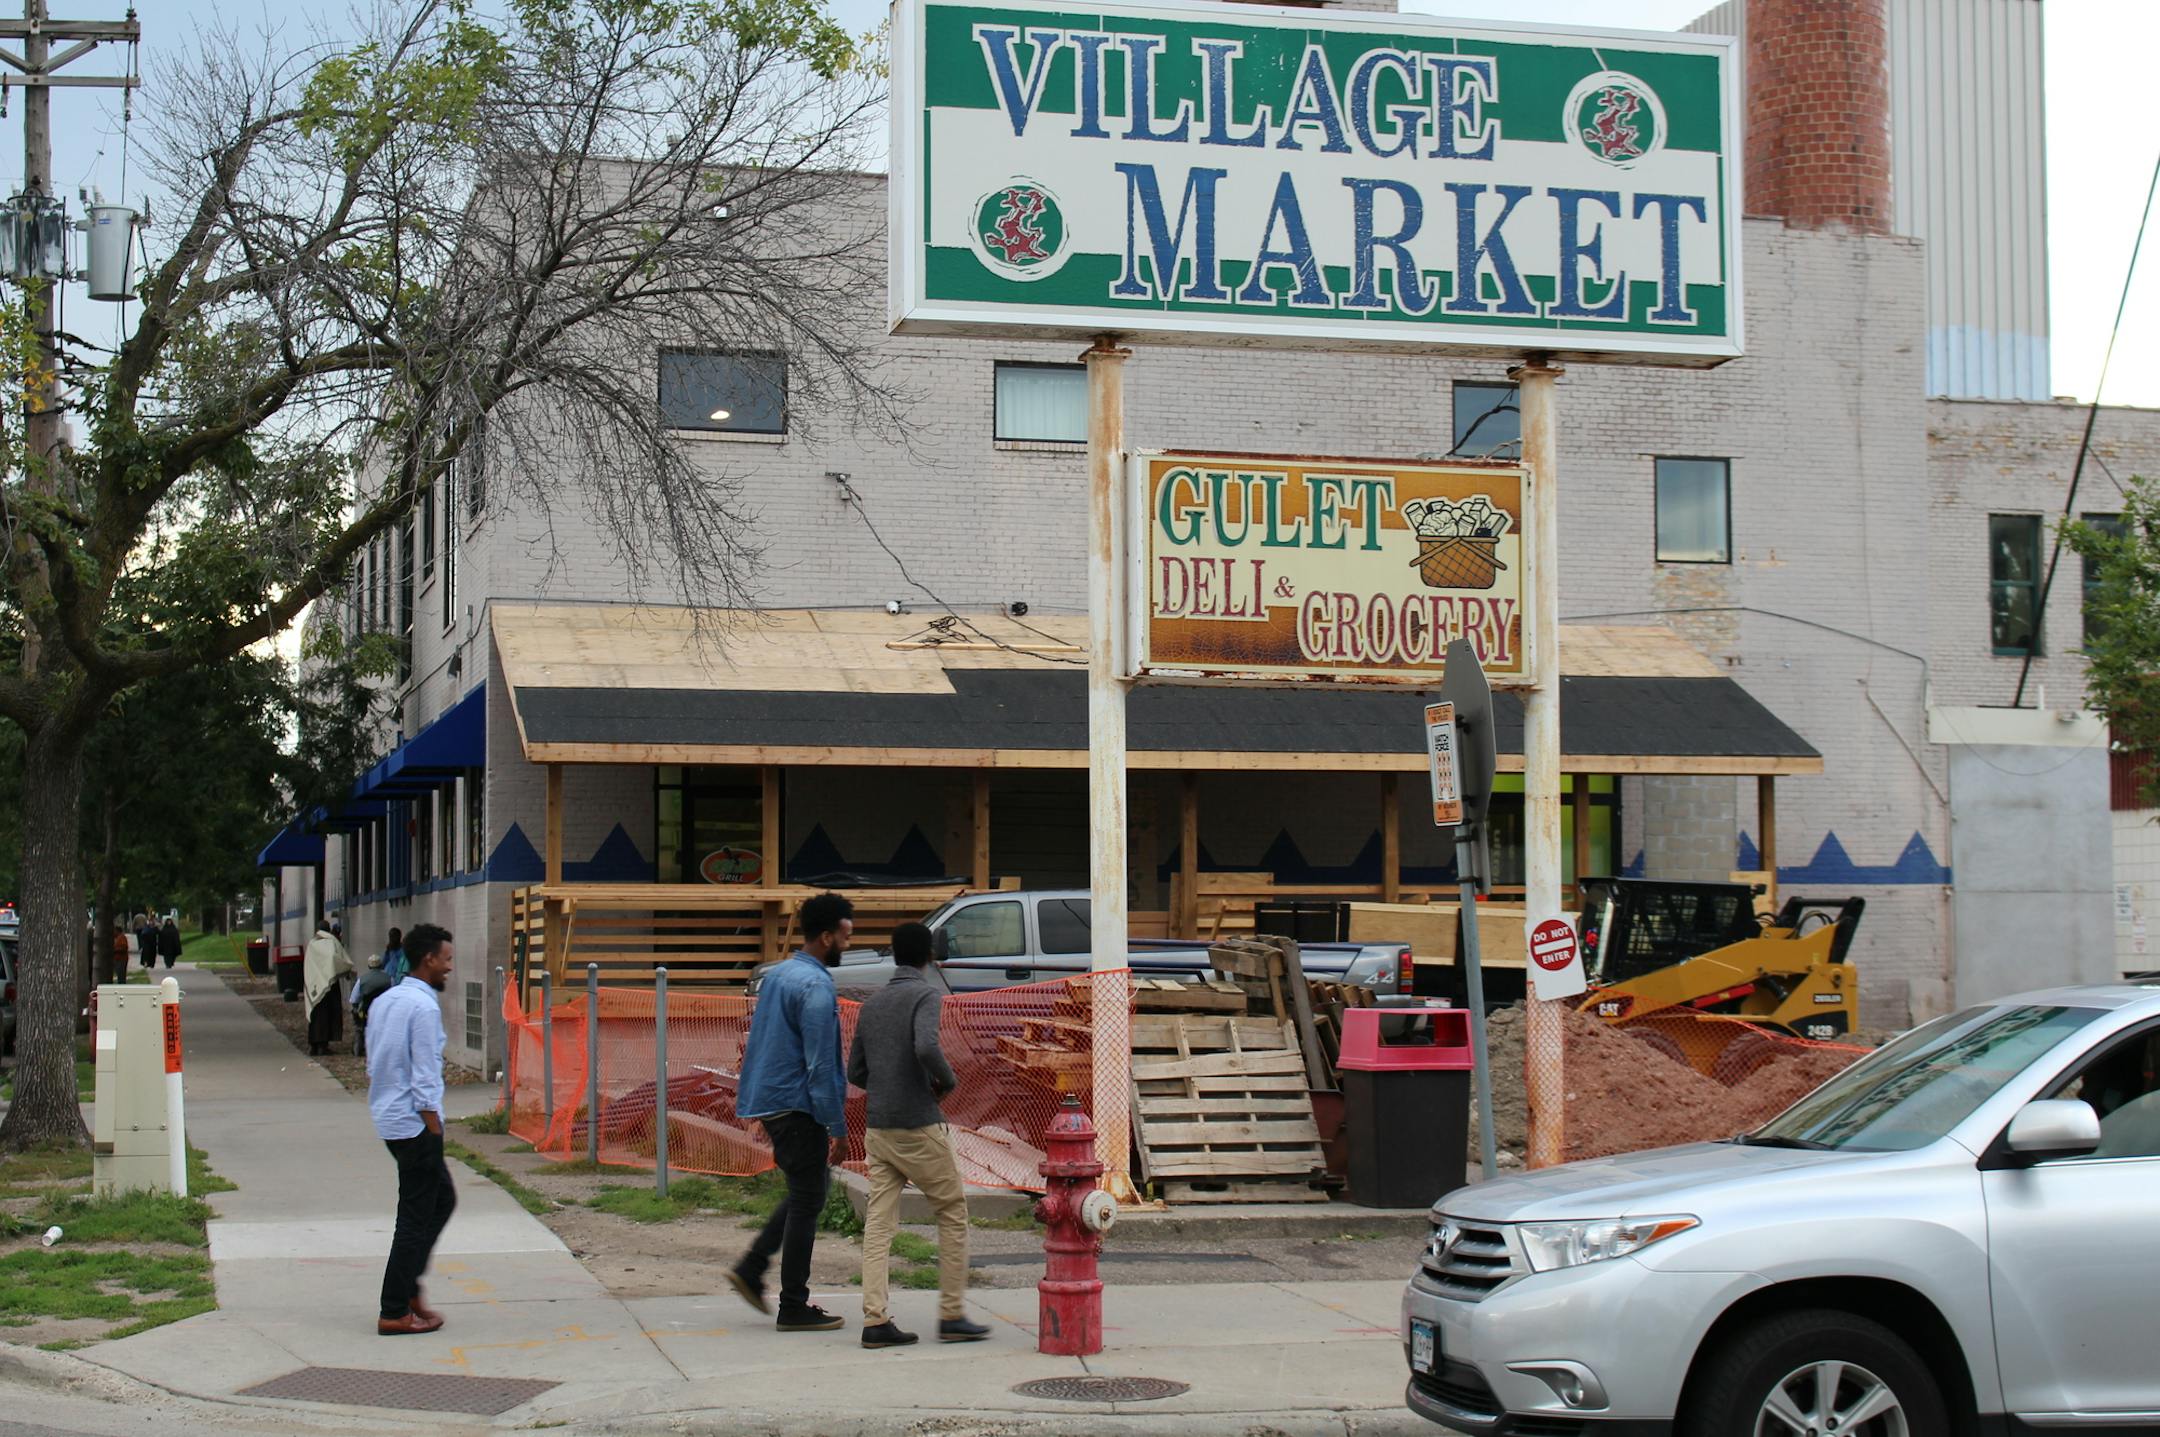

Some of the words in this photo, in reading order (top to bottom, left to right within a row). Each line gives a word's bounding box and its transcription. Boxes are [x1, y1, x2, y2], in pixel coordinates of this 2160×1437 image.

[974, 26, 1499, 162] VILLAGE
[1108, 161, 1706, 325] MARKET
[1157, 469, 1394, 552] GULET
[1159, 555, 1267, 618] DELI
[1273, 575, 1296, 599] &
[1301, 589, 1516, 662] GROCERY
[719, 873, 744, 882] GRILL
[1533, 932, 1547, 942] DO
[1551, 926, 1570, 938] NOT
[1542, 950, 1571, 964] ENTER
[1599, 1002, 1620, 1017] CAT
